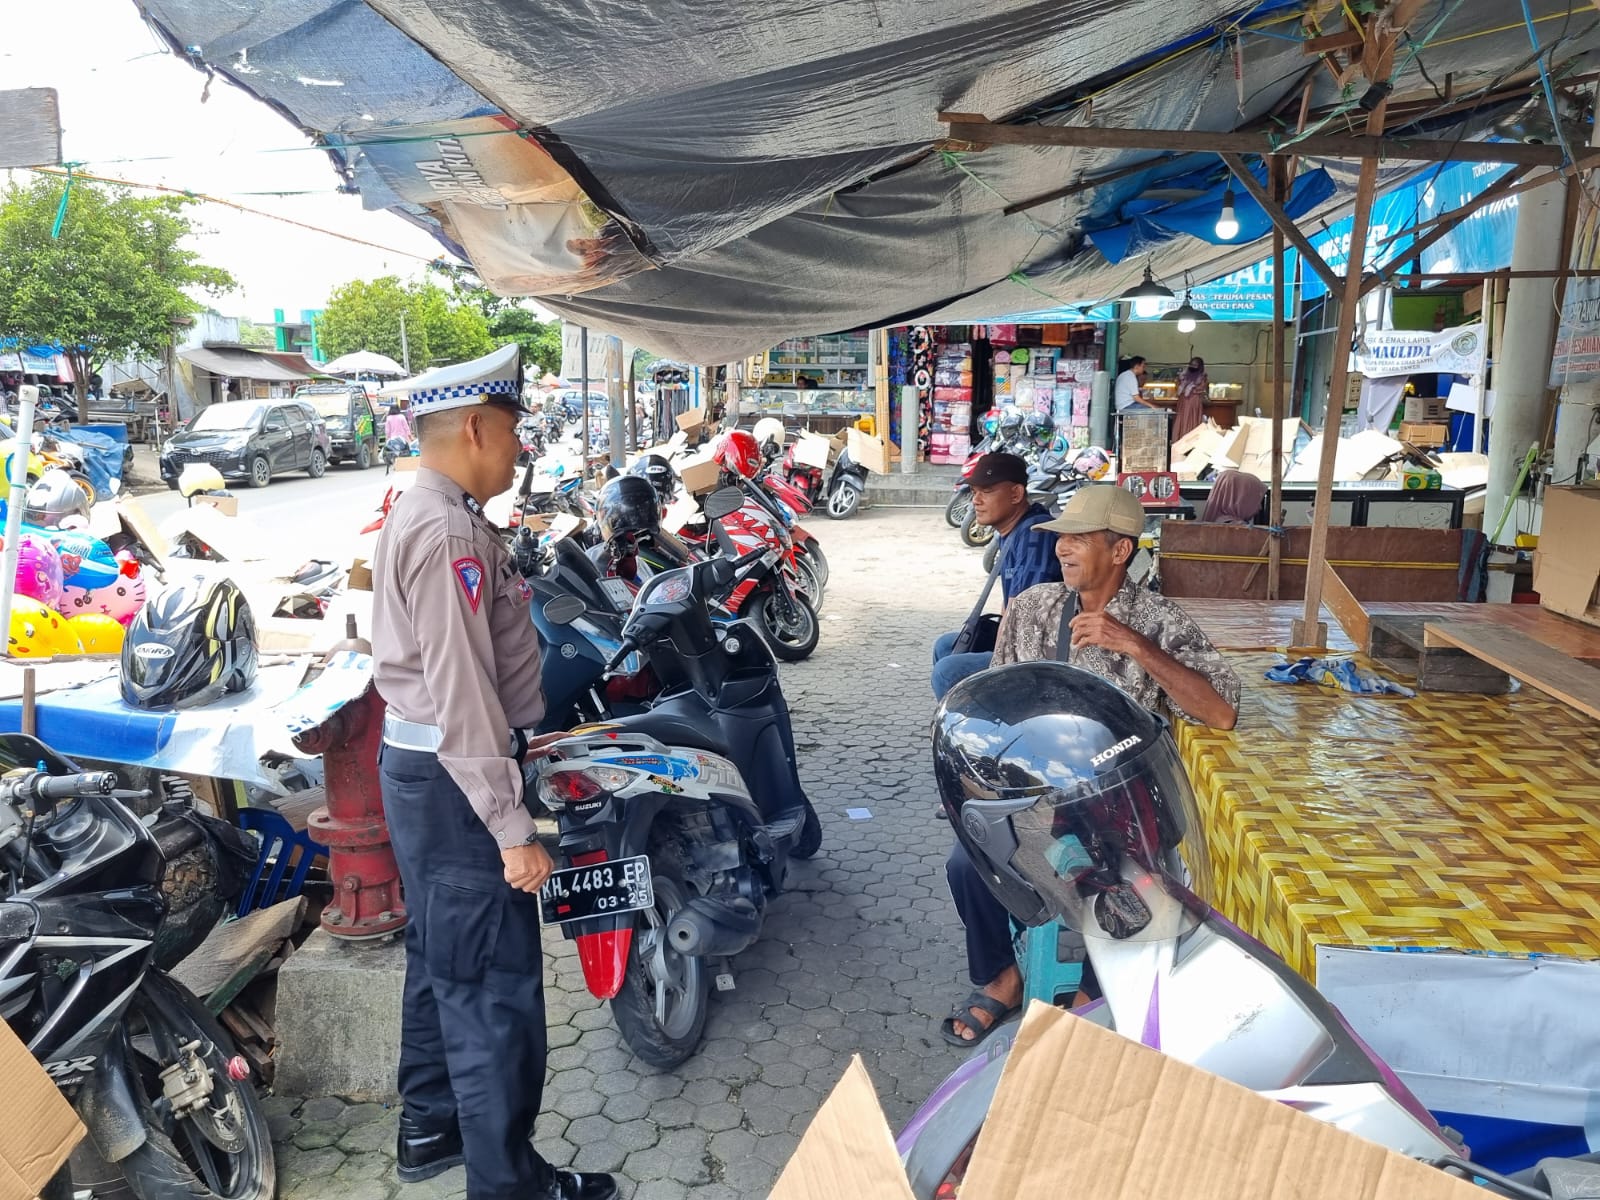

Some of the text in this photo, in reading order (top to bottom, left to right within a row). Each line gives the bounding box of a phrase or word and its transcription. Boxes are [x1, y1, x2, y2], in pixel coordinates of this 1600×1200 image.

[1090, 735, 1142, 767] HONDA
[574, 802, 602, 812] SUZUKI
[542, 861, 645, 900] KH 4483 EP
[43, 1055, 97, 1077] BR
